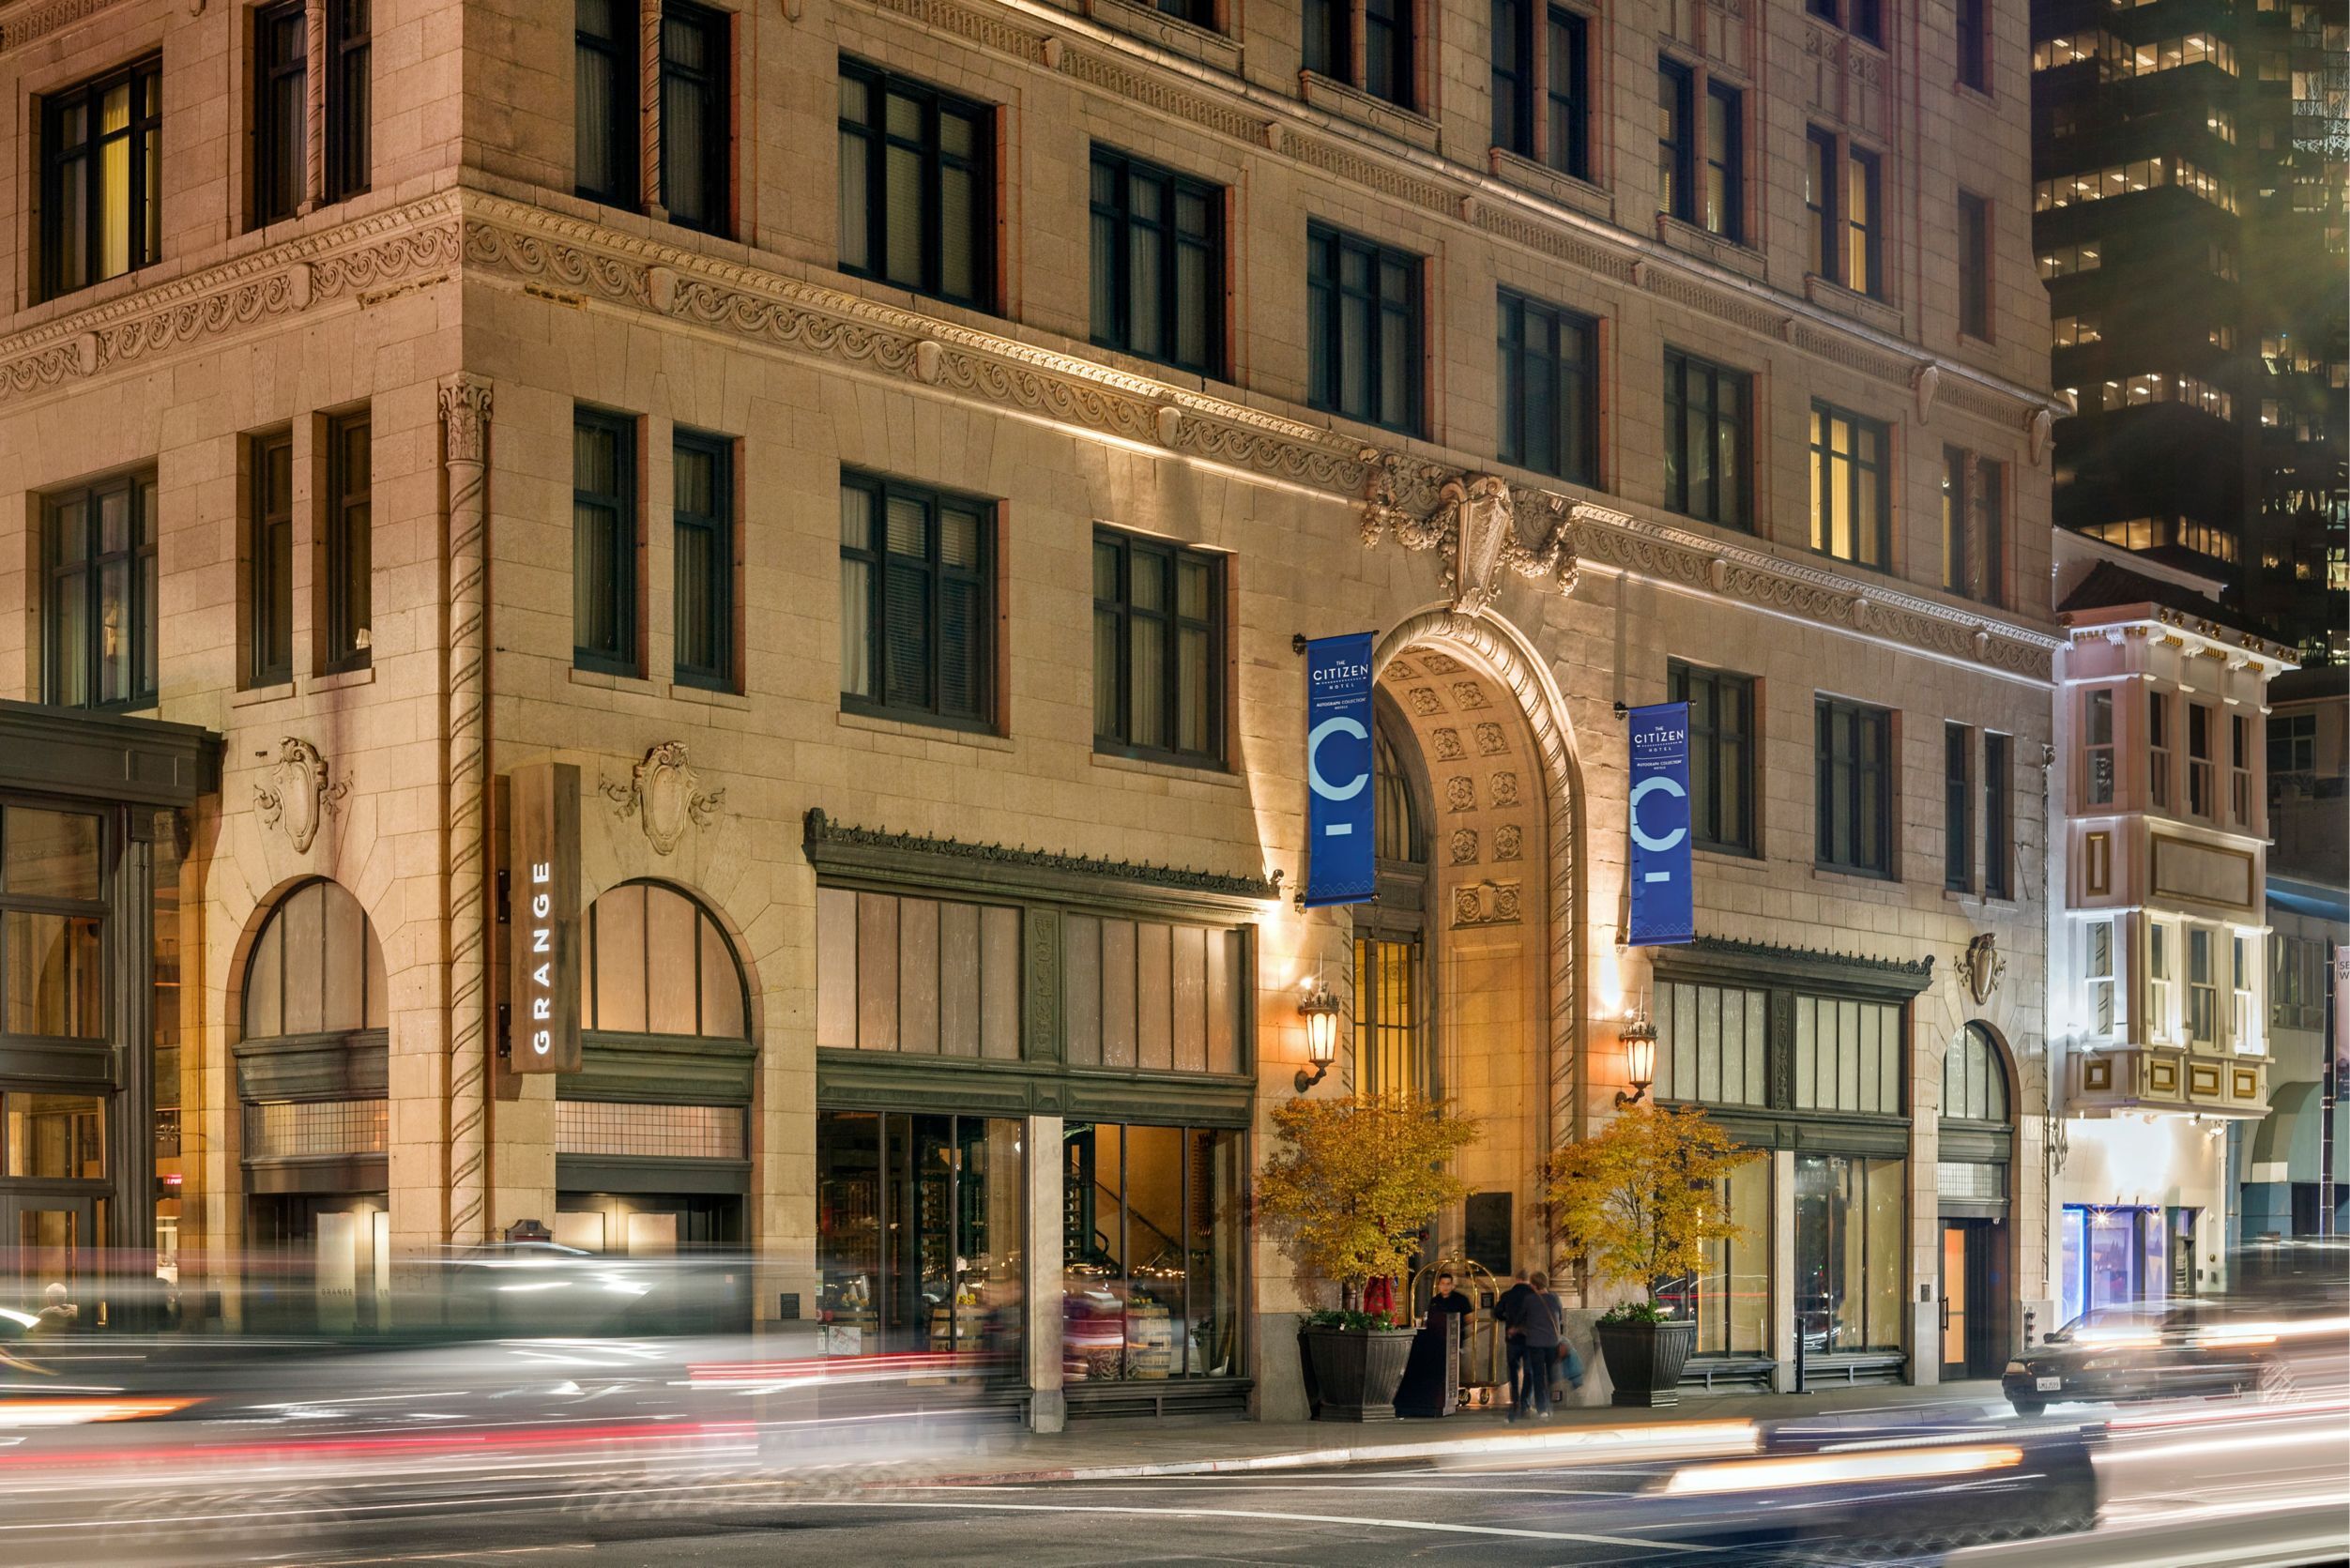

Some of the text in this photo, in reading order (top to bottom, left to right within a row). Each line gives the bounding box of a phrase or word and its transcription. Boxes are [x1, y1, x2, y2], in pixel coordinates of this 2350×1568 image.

[1313, 663, 1368, 681] CITIZEN
[1308, 716, 1368, 801] C
[1634, 729, 1684, 744] CITIZEN
[1630, 776, 1686, 852] C
[532, 861, 550, 1056] GRANGE
